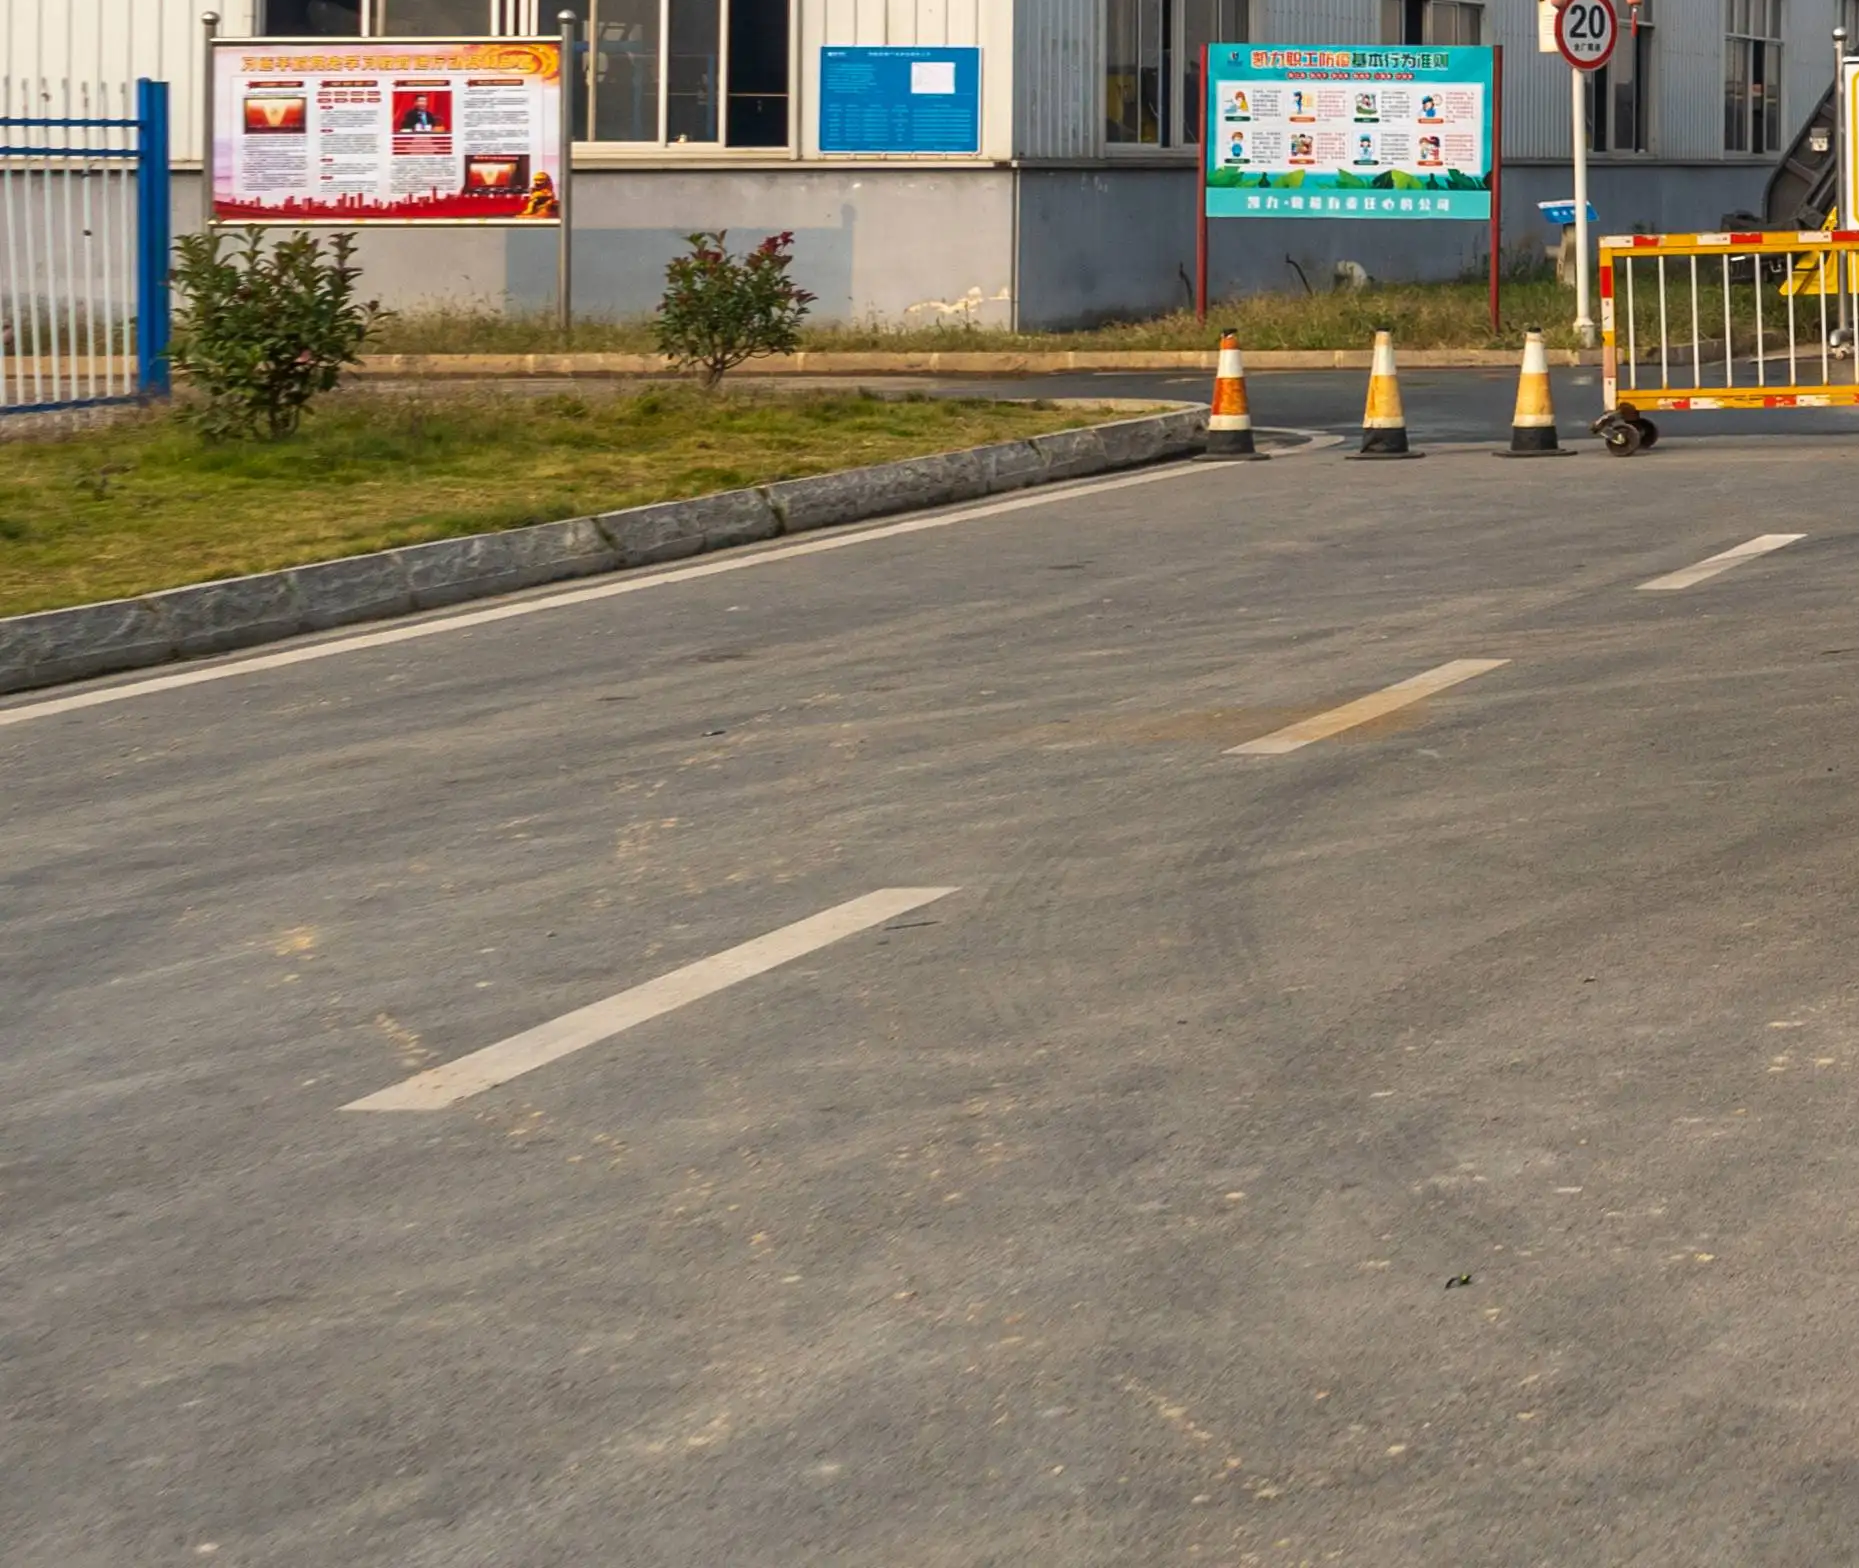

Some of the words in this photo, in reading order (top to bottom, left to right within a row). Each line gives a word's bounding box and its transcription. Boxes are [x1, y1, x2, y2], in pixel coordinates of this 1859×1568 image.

[1569, 4, 1606, 39] 20
[1251, 50, 1450, 70] 凯力职工防疫基本行为准则
